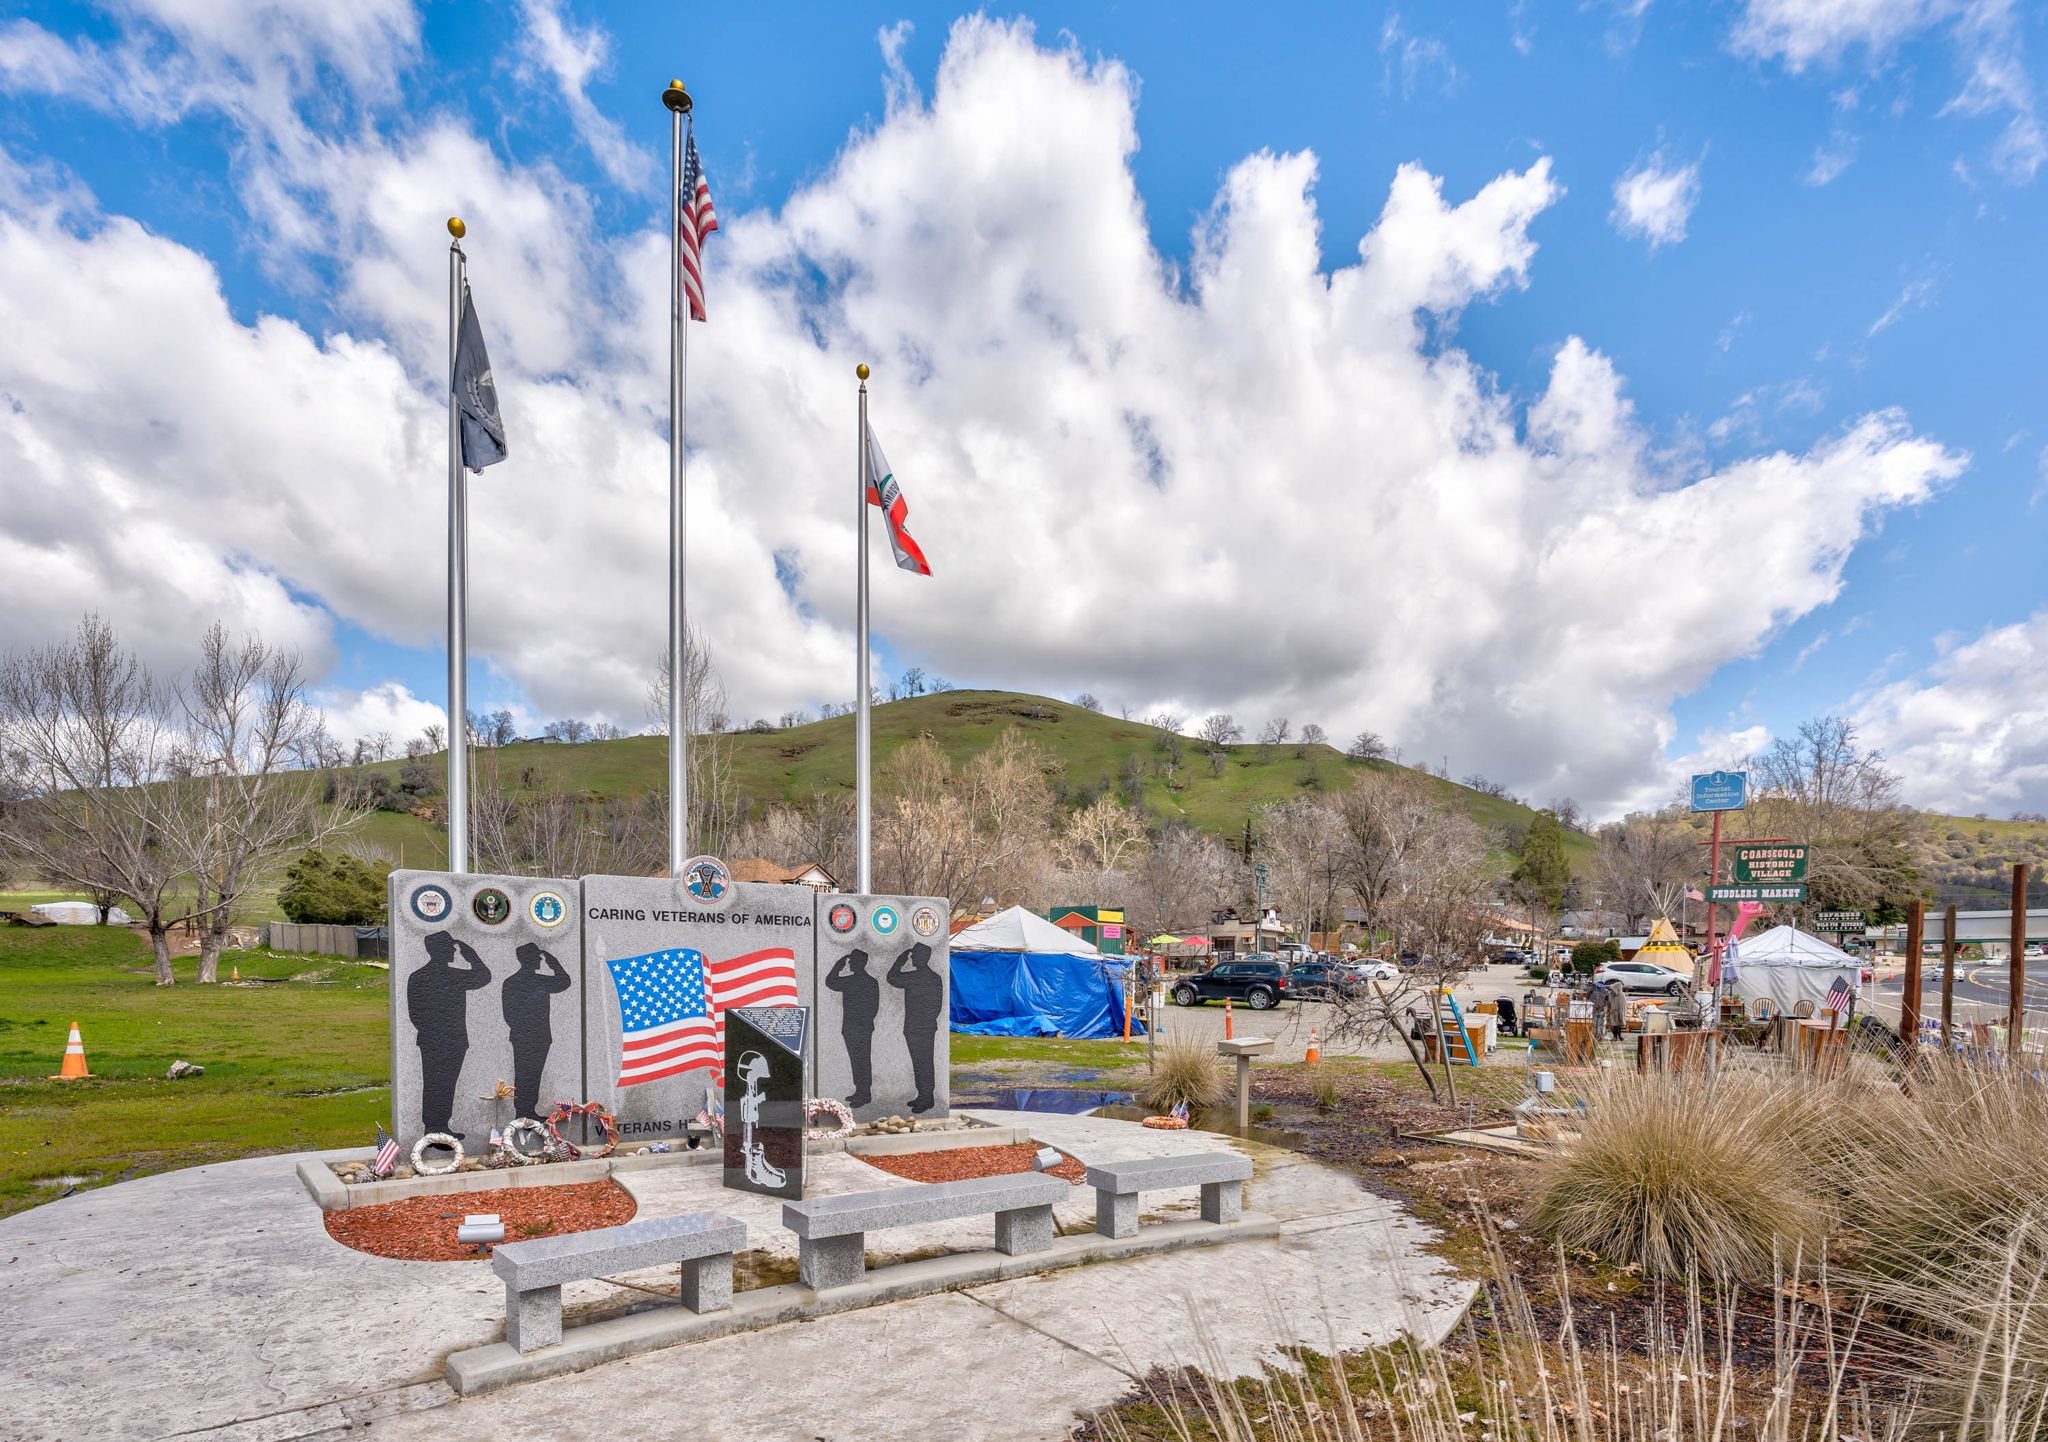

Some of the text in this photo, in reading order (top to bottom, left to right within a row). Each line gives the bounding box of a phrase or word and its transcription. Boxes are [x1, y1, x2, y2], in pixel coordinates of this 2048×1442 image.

[1740, 848, 1805, 860] COARSEGOLD
[1748, 860, 1795, 869] HISTORIC
[1750, 870, 1792, 878] VILLAGE
[1712, 888, 1801, 898] PEDDLERS MARKET
[588, 907, 812, 927] CARING VETERANS OF AMERICA
[595, 1120, 672, 1137] VTERANS
